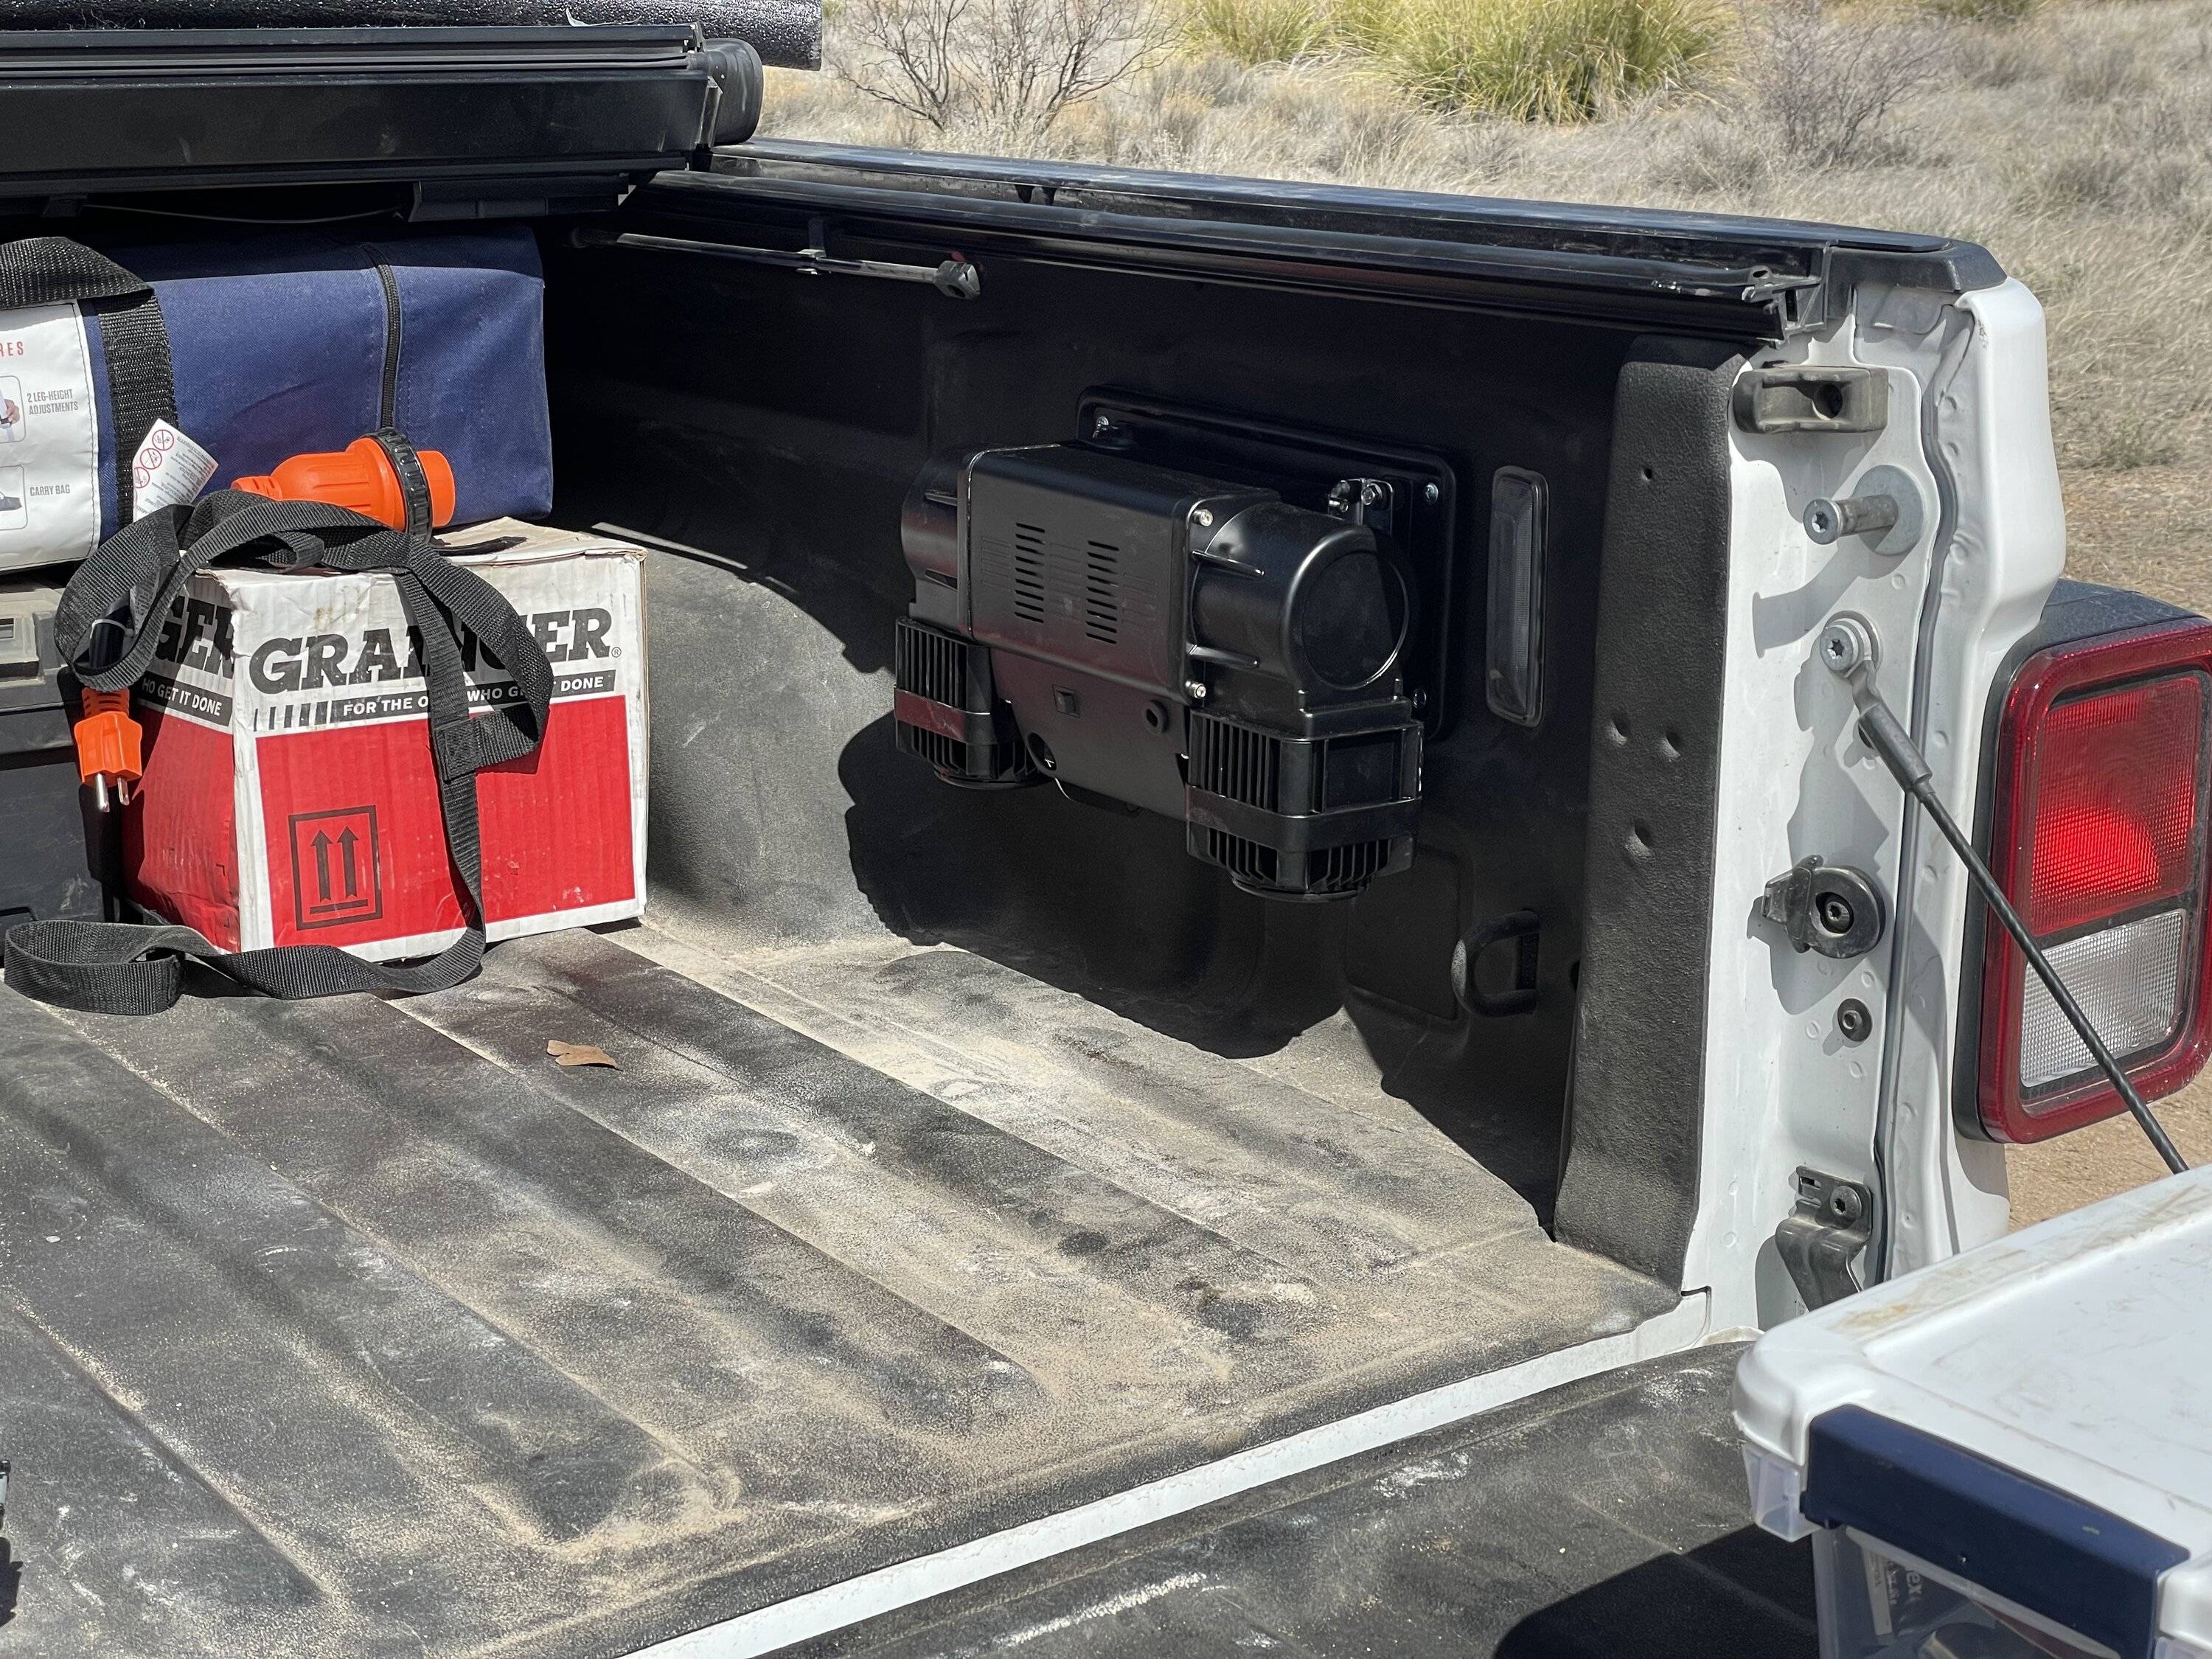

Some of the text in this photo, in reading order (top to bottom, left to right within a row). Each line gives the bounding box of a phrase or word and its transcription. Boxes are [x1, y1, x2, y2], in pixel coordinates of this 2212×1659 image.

[27, 389, 73, 403] 2 LEG-HEIGHT
[29, 401, 79, 415] ADJUSTMENTS
[29, 484, 70, 496] CARRY BAG
[249, 608, 612, 695] GRAIER
[157, 684, 179, 701] GET
[179, 690, 191, 706] IT
[192, 694, 223, 717] DONE
[343, 700, 377, 717] FOR
[381, 697, 413, 712] THE
[466, 688, 503, 702] WHO
[560, 676, 604, 692] DONE
